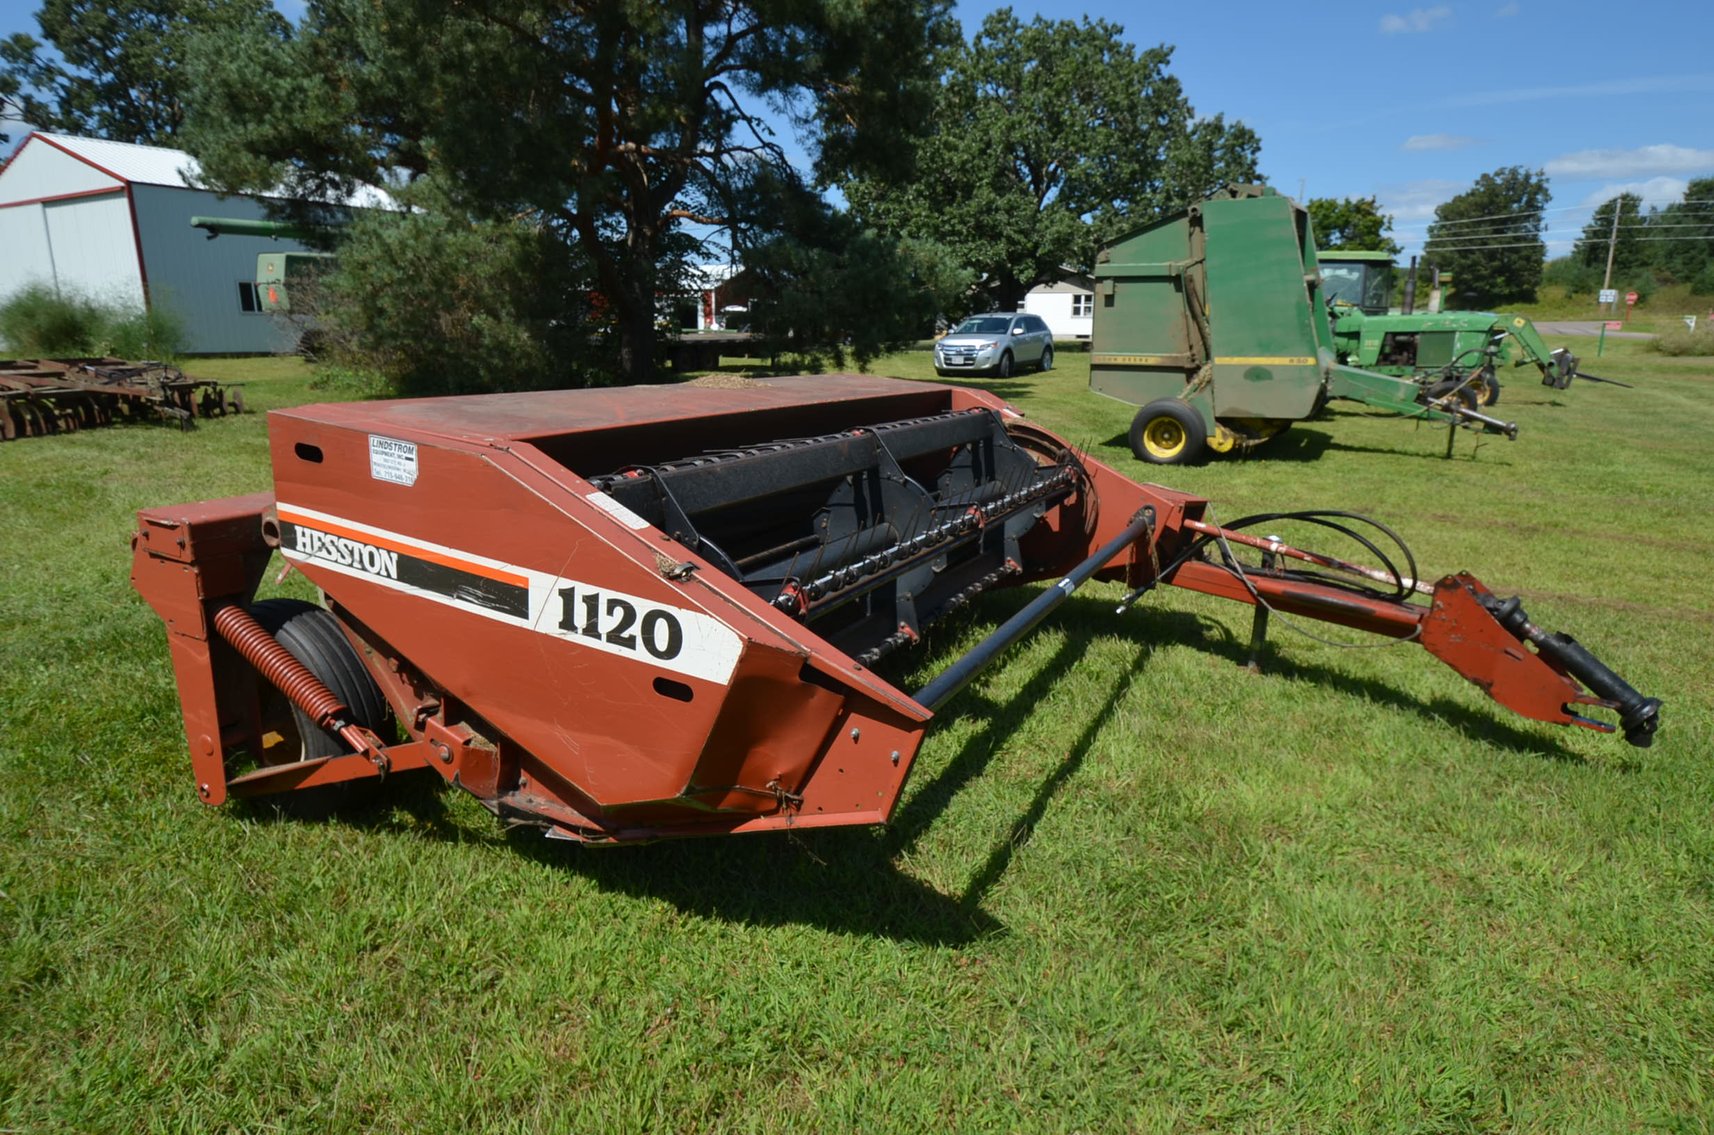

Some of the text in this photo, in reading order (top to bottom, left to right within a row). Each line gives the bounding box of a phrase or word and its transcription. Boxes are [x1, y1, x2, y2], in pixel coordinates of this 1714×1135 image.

[372, 439, 414, 455] LINDSTROM
[294, 524, 398, 580] HESSTON
[558, 586, 683, 661] 1120
